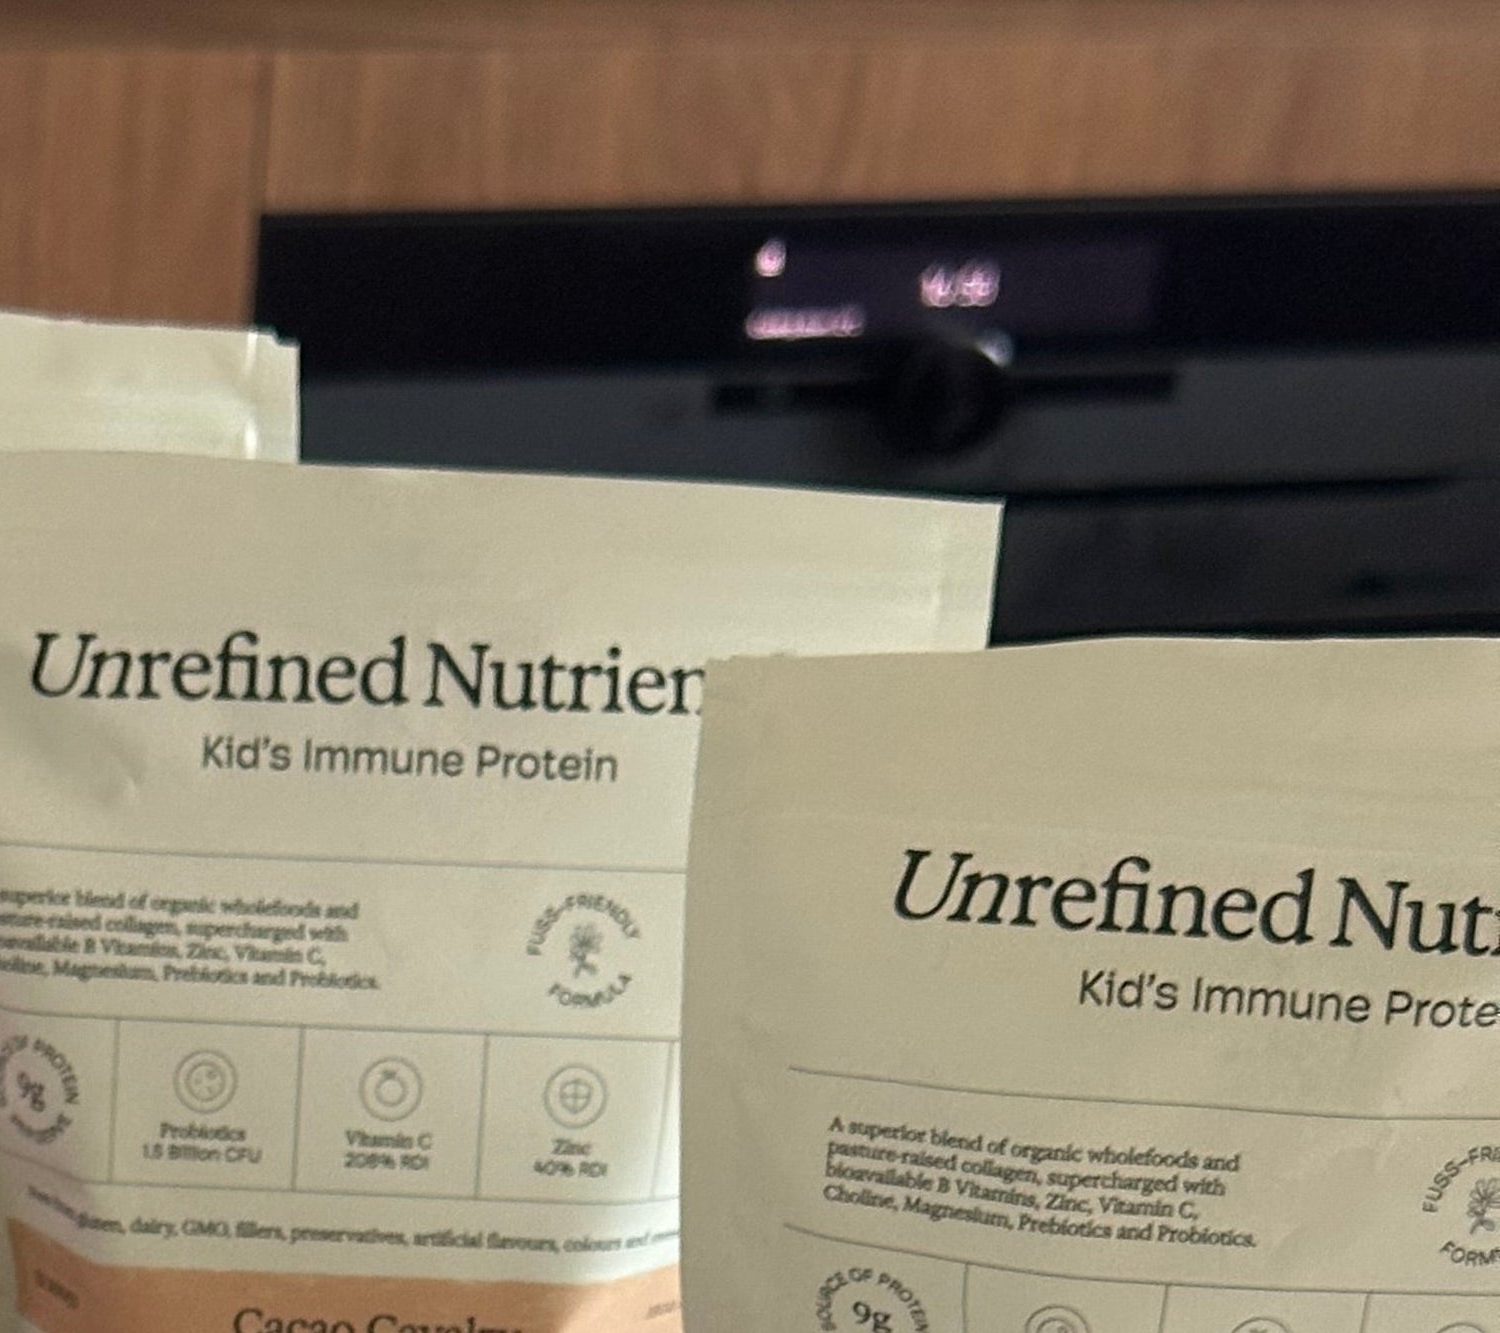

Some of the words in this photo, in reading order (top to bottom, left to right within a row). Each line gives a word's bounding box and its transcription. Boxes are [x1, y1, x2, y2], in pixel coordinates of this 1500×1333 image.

[29, 629, 409, 703] Unrefined
[200, 734, 292, 773] Kid's
[303, 738, 465, 779] Immune
[475, 743, 619, 783] Protein
[75, 888, 125, 908] blend
[128, 891, 149, 909] of
[150, 894, 215, 915] organic
[219, 896, 321, 918] wholefoods
[325, 901, 360, 920] and
[894, 848, 1315, 948] Unrefined
[1329, 876, 1500, 958] Nut
[185, 921, 305, 943] supercharged
[309, 924, 349, 942] with
[233, 944, 303, 963] Vitamin
[164, 964, 248, 985] Prebiotics
[253, 968, 286, 986] and
[1078, 969, 1178, 1009] Kid's
[1192, 976, 1370, 1023] Immune
[1384, 989, 1500, 1028] Prote
[160, 1122, 247, 1142] Probiotics
[345, 1130, 414, 1149] Vitamin
[417, 1132, 433, 1150] C
[551, 1138, 592, 1156] Zinc
[828, 1116, 844, 1133] A
[849, 1121, 926, 1144] superior
[930, 1129, 983, 1152] blend
[988, 1134, 1008, 1154] of
[1010, 1141, 1082, 1167] organic
[1088, 1146, 1198, 1170] wholefoods
[1202, 1153, 1240, 1172] and
[167, 1145, 221, 1162] Billion
[224, 1146, 263, 1164] CFU
[578, 1161, 607, 1178] RDI
[826, 1140, 956, 1172] pasture-raised
[961, 1159, 1041, 1187] collagen,
[1047, 1170, 1178, 1197] supercharged
[1183, 1177, 1227, 1197] with
[825, 1161, 933, 1192] bioavailable
[937, 1177, 951, 1195] B
[955, 1179, 1040, 1211] Vitamins,
[1045, 1192, 1093, 1215] Zinc,
[1098, 1196, 1174, 1218] Vitamin
[1179, 1202, 1199, 1222] C,
[822, 1184, 898, 1212] Choline,
[902, 1197, 1013, 1230] Magnesium,
[1019, 1214, 1112, 1240] Prebiotics
[1116, 1222, 1152, 1241] and
[1157, 1224, 1257, 1248] Probiotics.
[413, 1228, 482, 1248] artificial
[878, 1272, 930, 1333] PROTEIN
